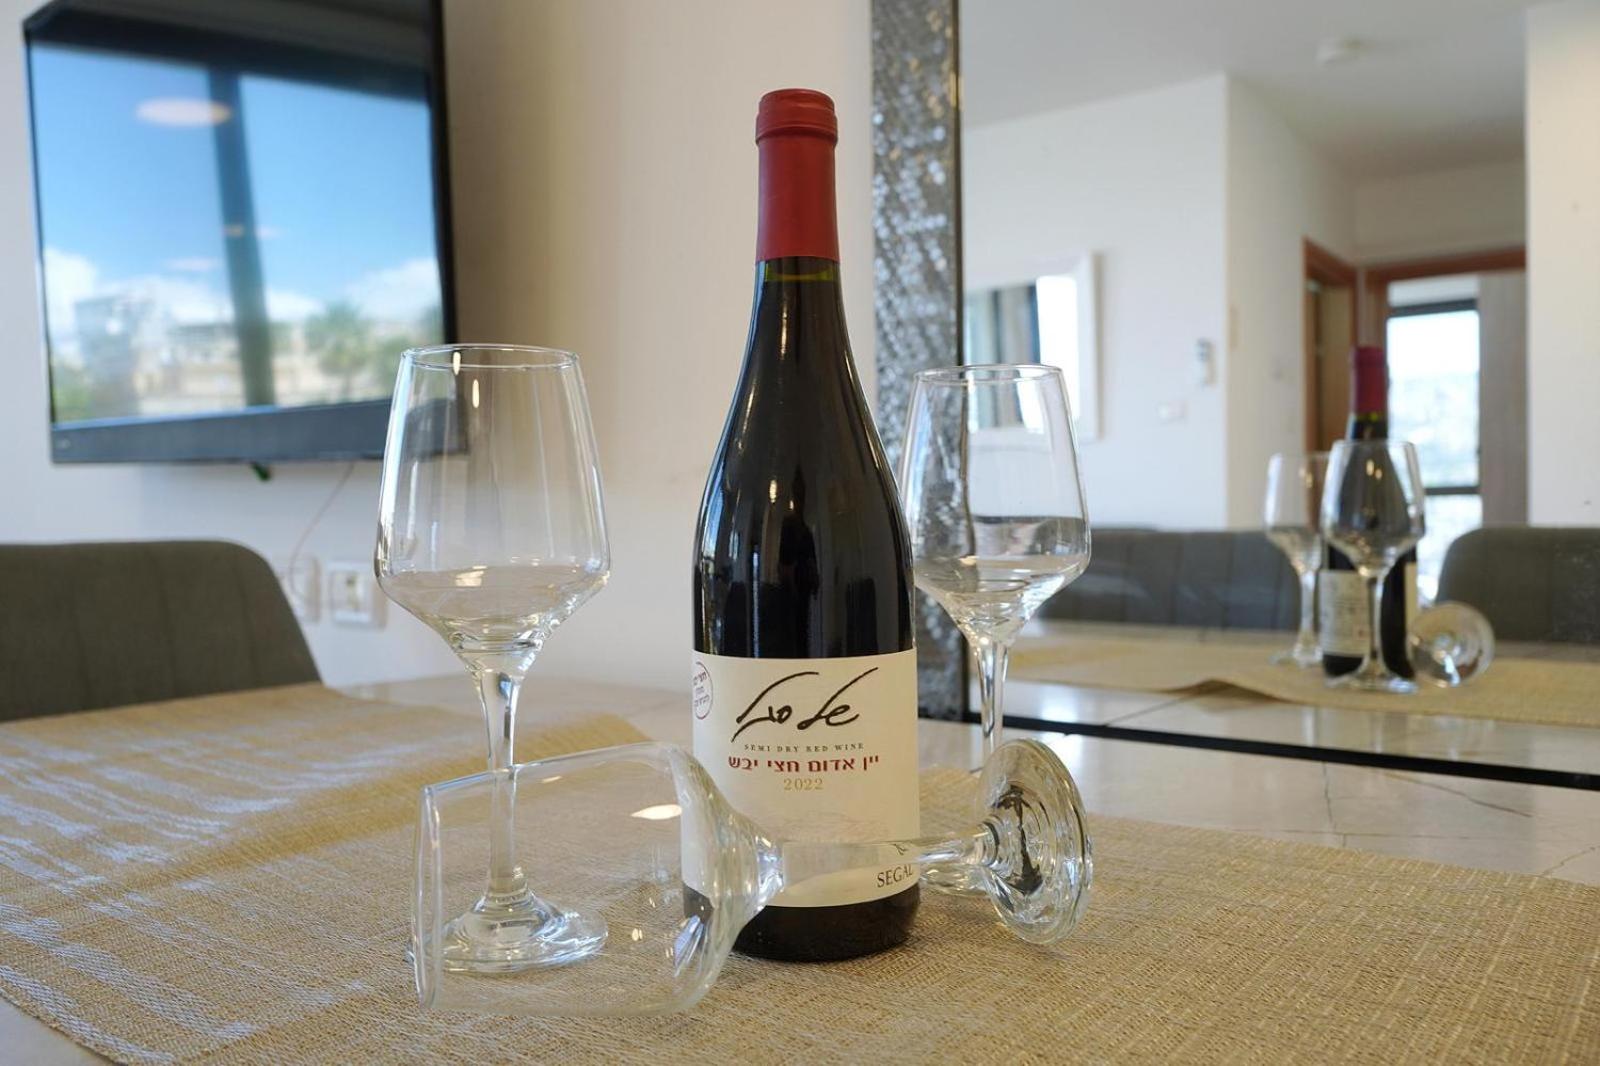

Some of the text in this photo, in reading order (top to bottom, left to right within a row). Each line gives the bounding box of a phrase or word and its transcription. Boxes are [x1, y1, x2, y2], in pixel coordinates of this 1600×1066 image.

[744, 743, 864, 753] SEMI DRY RED WINE
[728, 755, 880, 773] יין אדום חצי יבש
[783, 777, 824, 791] 2022
[876, 863, 914, 889] SEGAL
